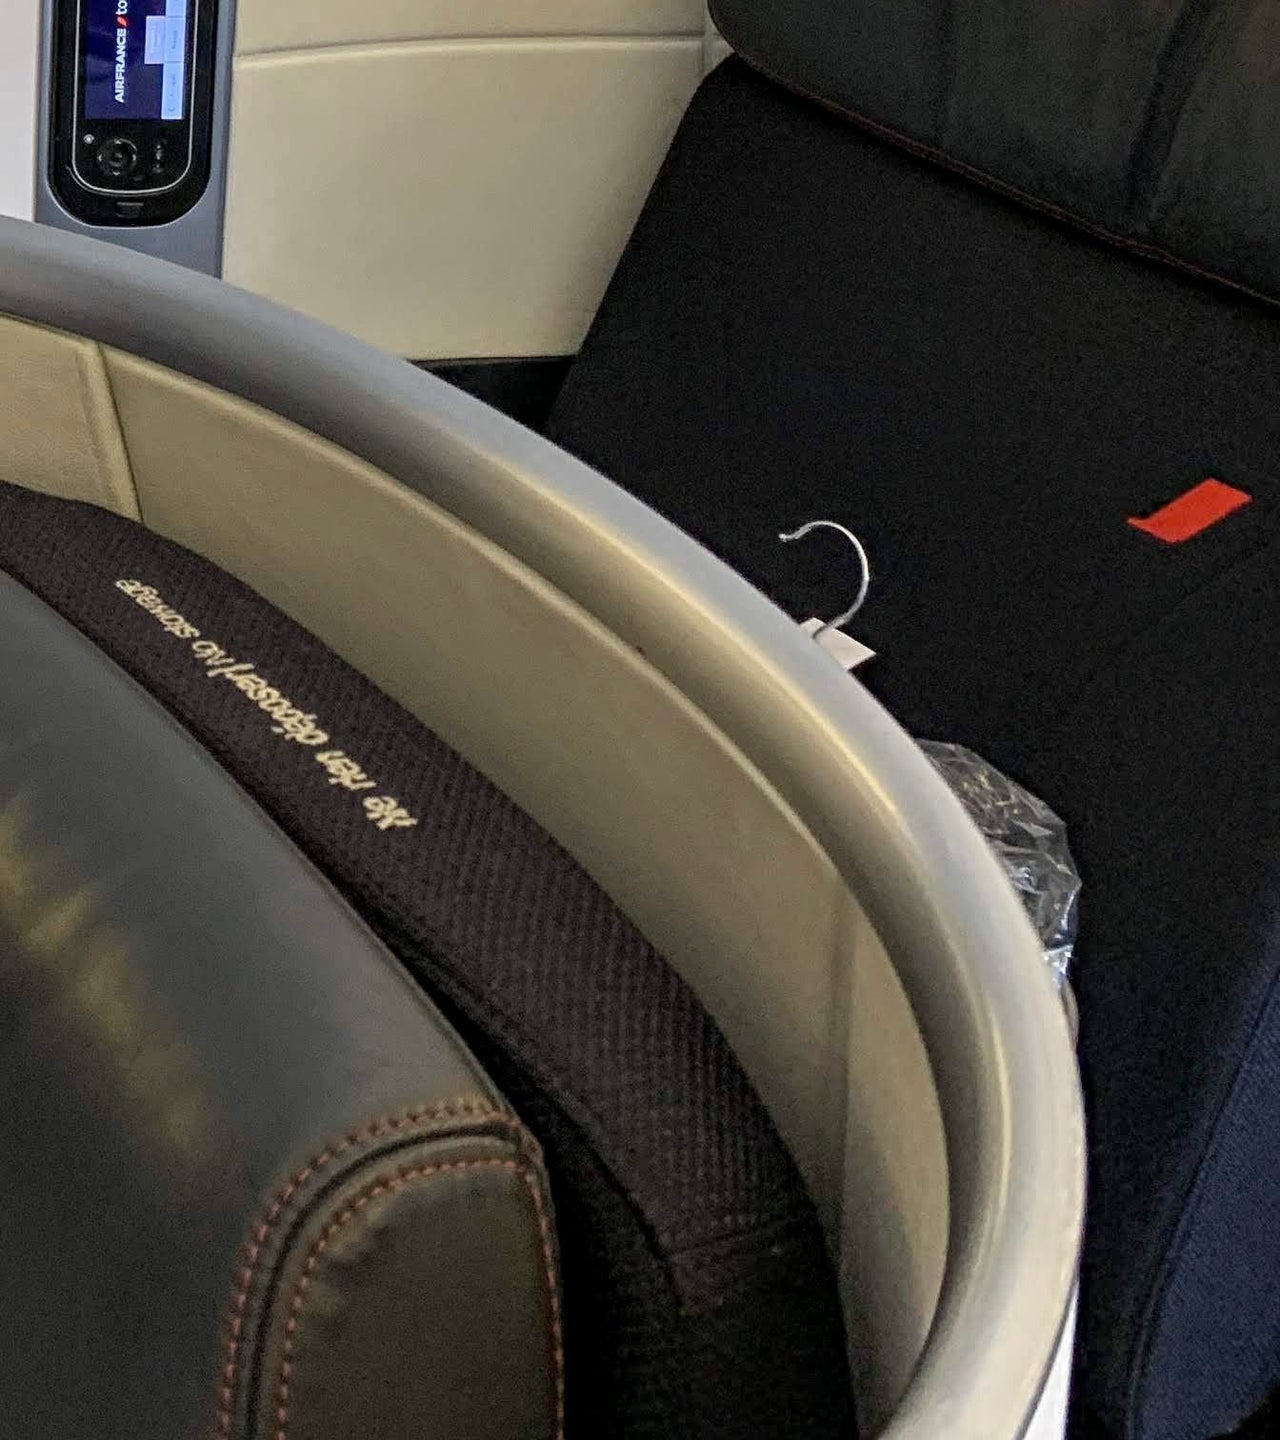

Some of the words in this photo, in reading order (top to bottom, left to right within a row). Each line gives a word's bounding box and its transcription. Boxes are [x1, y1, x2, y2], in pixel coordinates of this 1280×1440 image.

[114, 28, 127, 104] AIRFRANCE
[315, 750, 377, 791] rien
[363, 796, 418, 830] Ne
